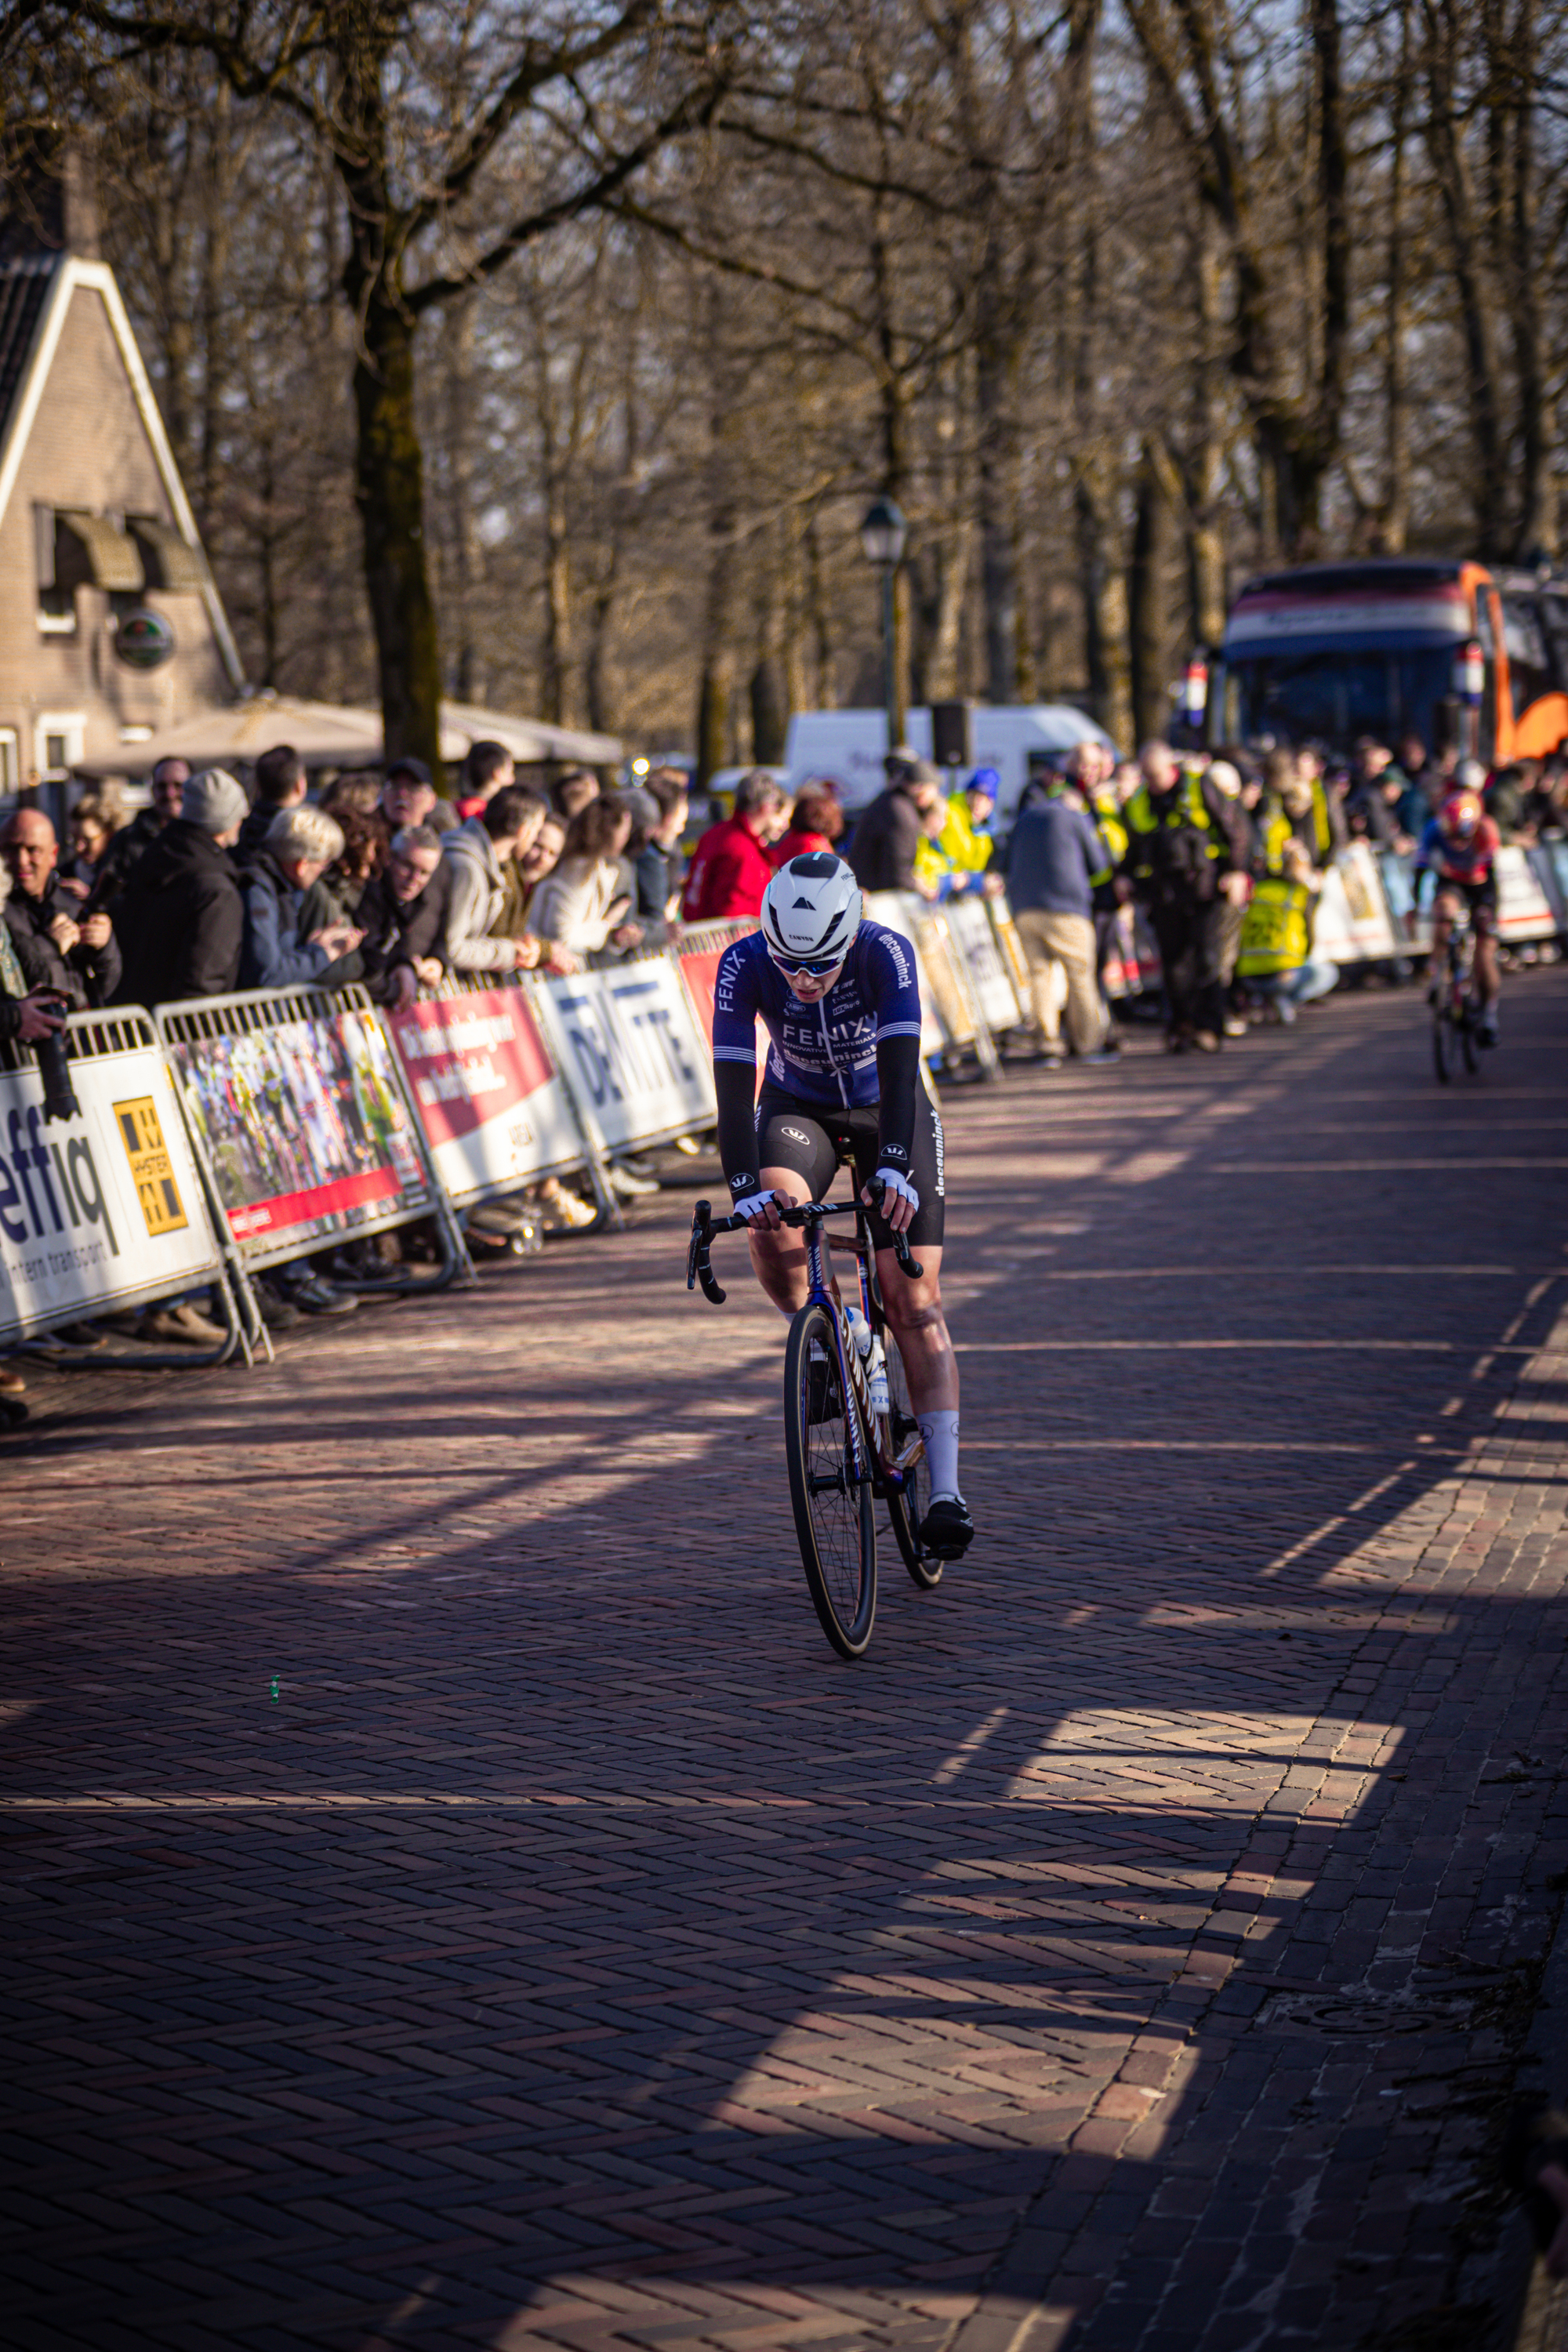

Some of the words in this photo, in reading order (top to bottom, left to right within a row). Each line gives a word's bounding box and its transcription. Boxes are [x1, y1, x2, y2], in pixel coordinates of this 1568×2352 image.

[718, 949, 746, 1012] FENIX
[878, 934, 912, 989] deceuninck
[782, 1017, 872, 1047] FENIX
[782, 1040, 828, 1054] INNOVATIVE
[833, 1033, 877, 1048] MATERIALS
[930, 1109, 945, 1196] deceuninck
[47, 1243, 107, 1275] transport
[814, 1246, 823, 1284] CANYON
